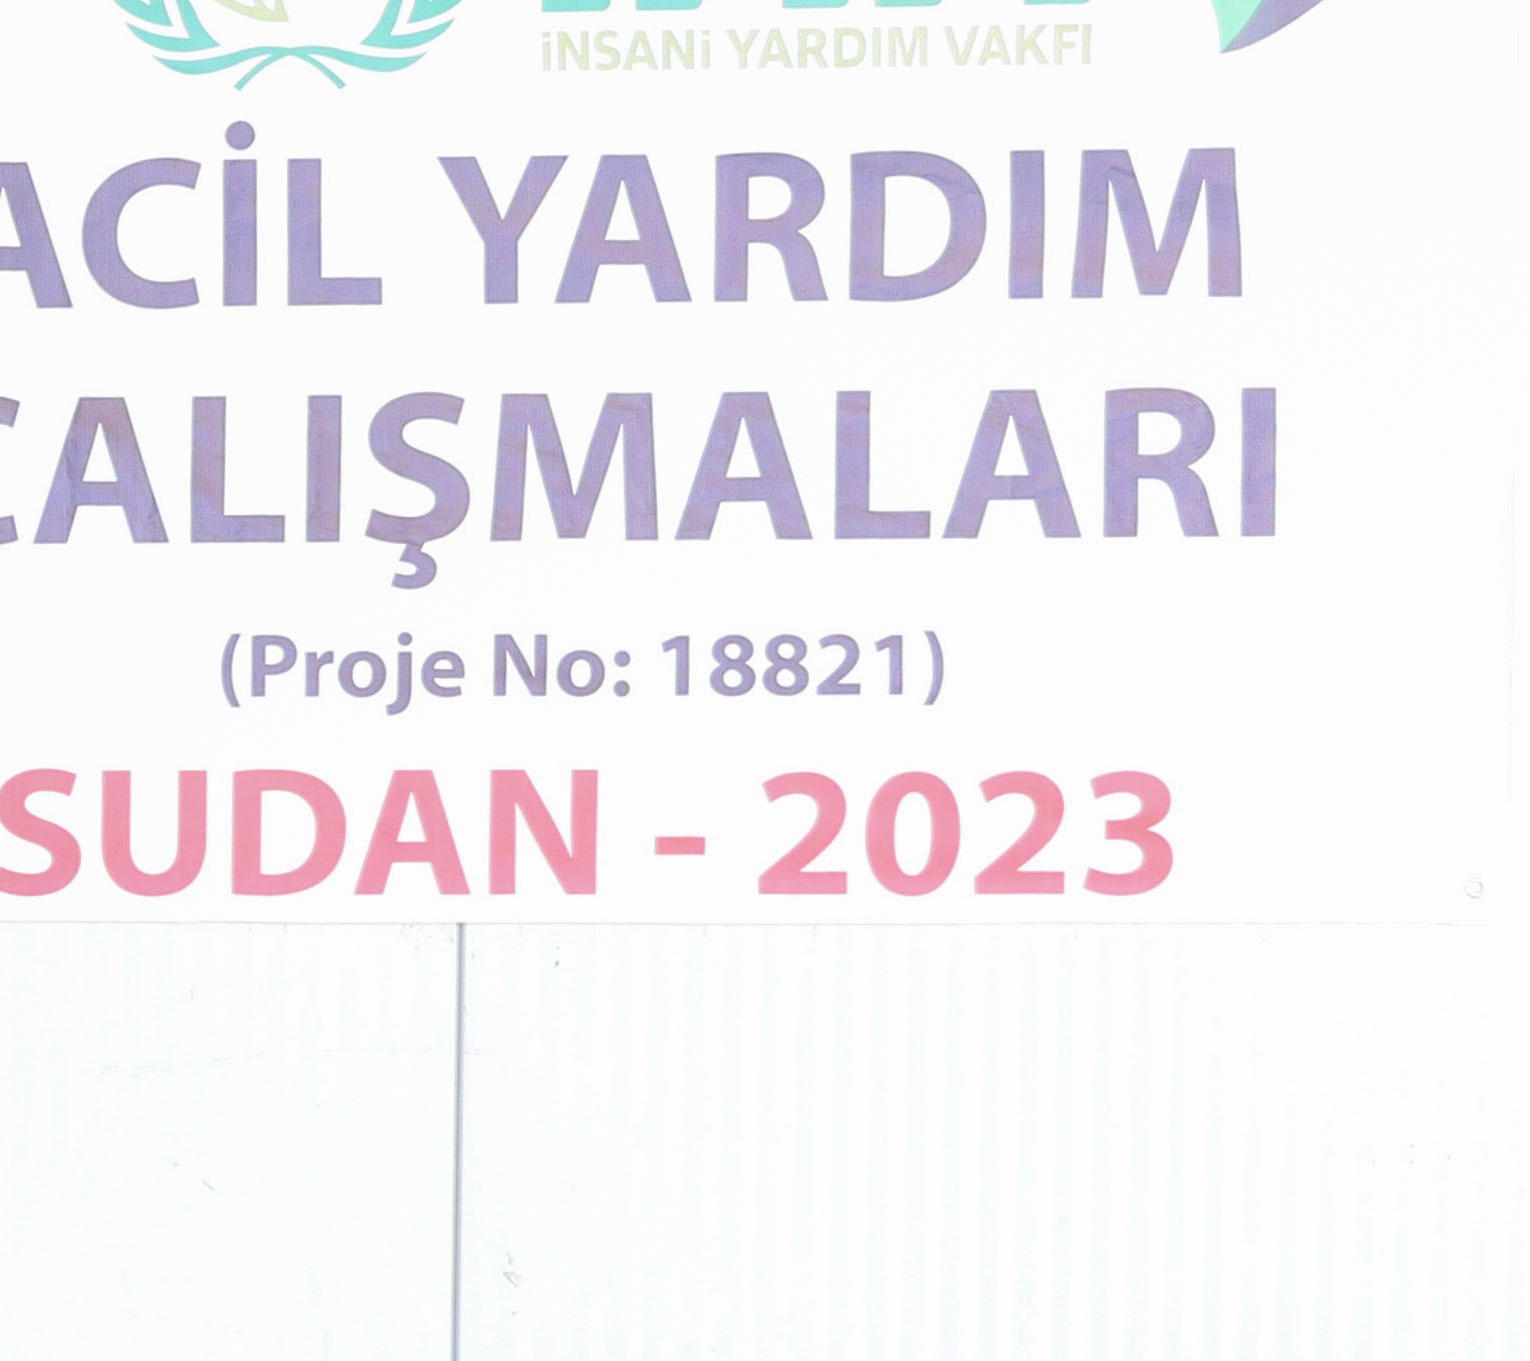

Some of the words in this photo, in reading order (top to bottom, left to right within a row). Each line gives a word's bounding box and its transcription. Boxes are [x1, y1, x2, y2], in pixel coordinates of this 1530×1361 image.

[727, 26, 929, 70] YARDIM
[944, 22, 1094, 66] VAKFI
[438, 148, 1242, 304] YARDIM
[219, 632, 467, 717] (Proje
[494, 634, 631, 697] No:
[661, 631, 946, 707] 18821)
[655, 836, 705, 855] -
[759, 771, 1174, 896] 2023
